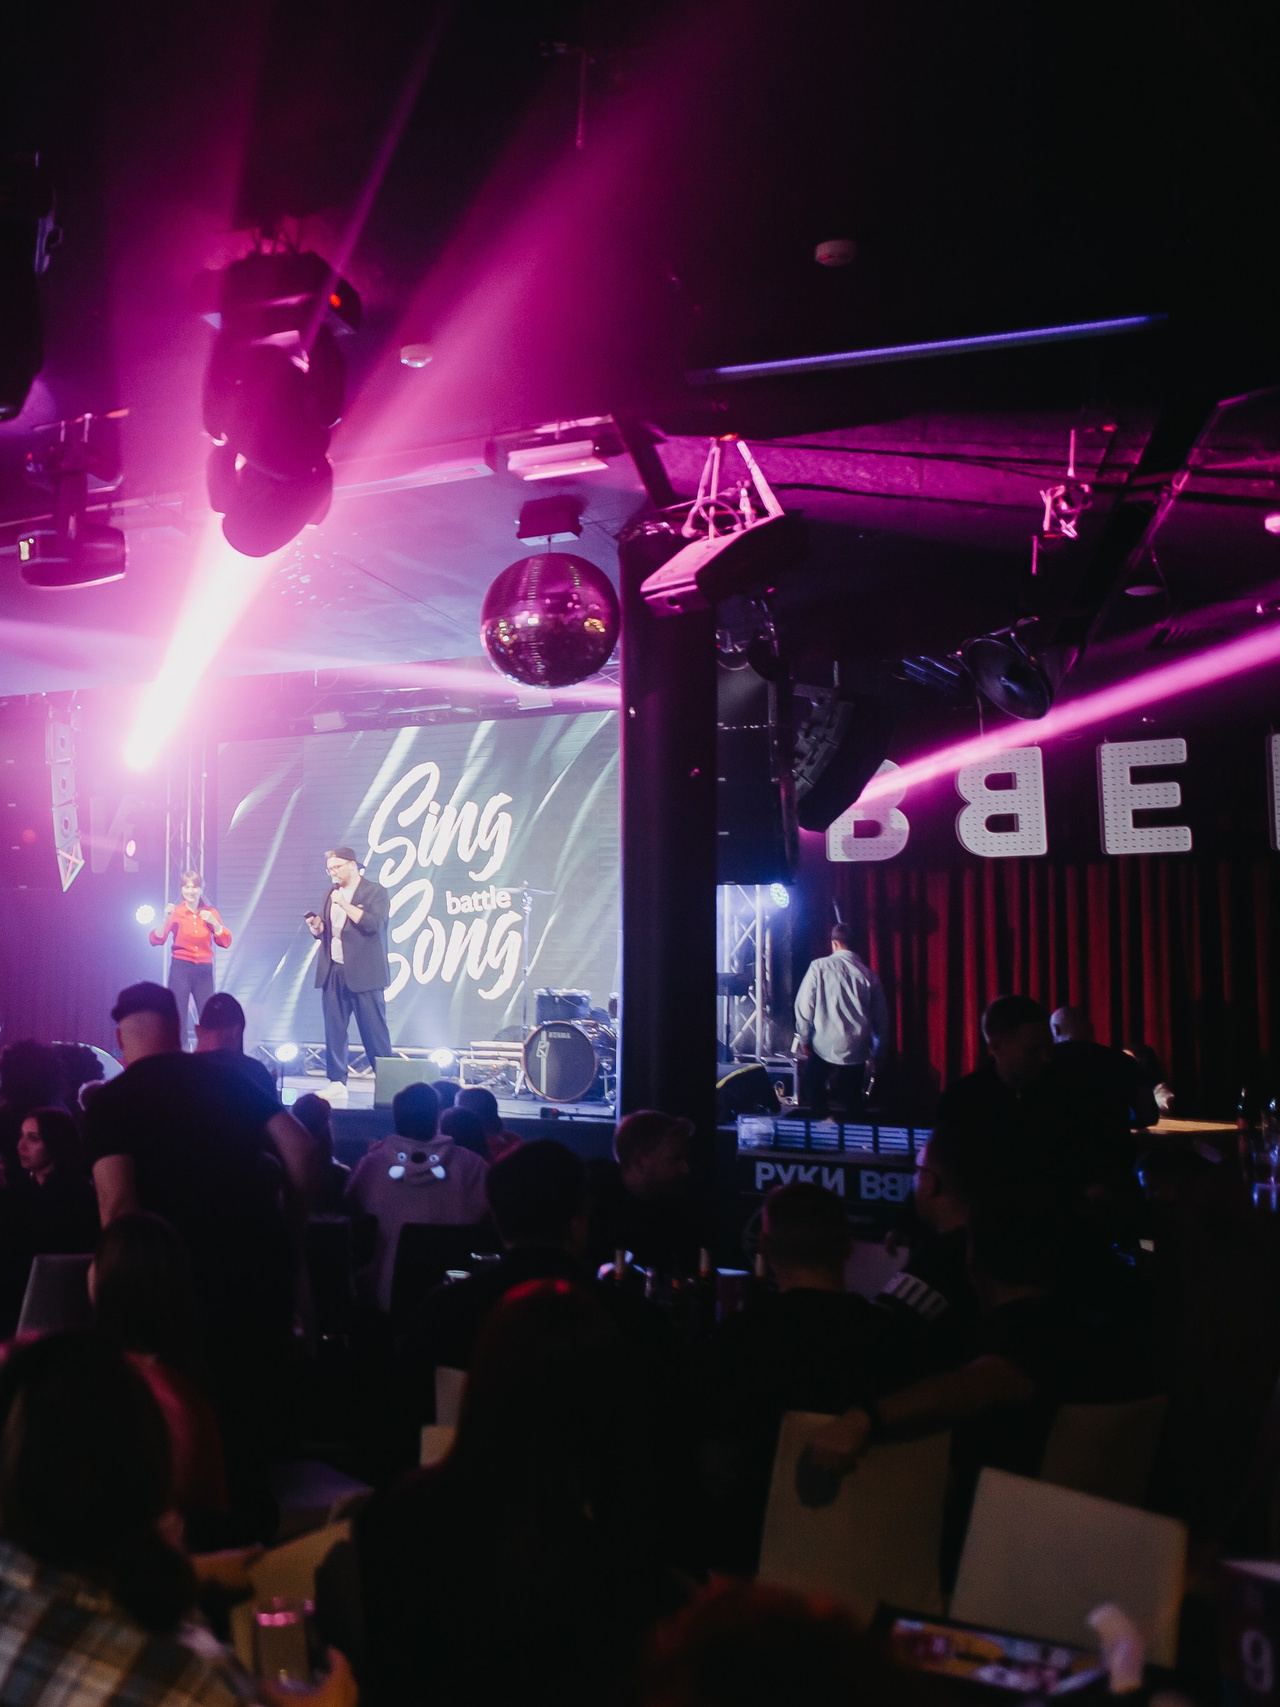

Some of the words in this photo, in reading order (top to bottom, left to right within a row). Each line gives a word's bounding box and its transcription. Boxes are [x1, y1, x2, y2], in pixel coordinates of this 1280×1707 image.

[364, 761, 514, 888] Sing
[384, 878, 523, 1002] Song
[446, 885, 512, 915] battle
